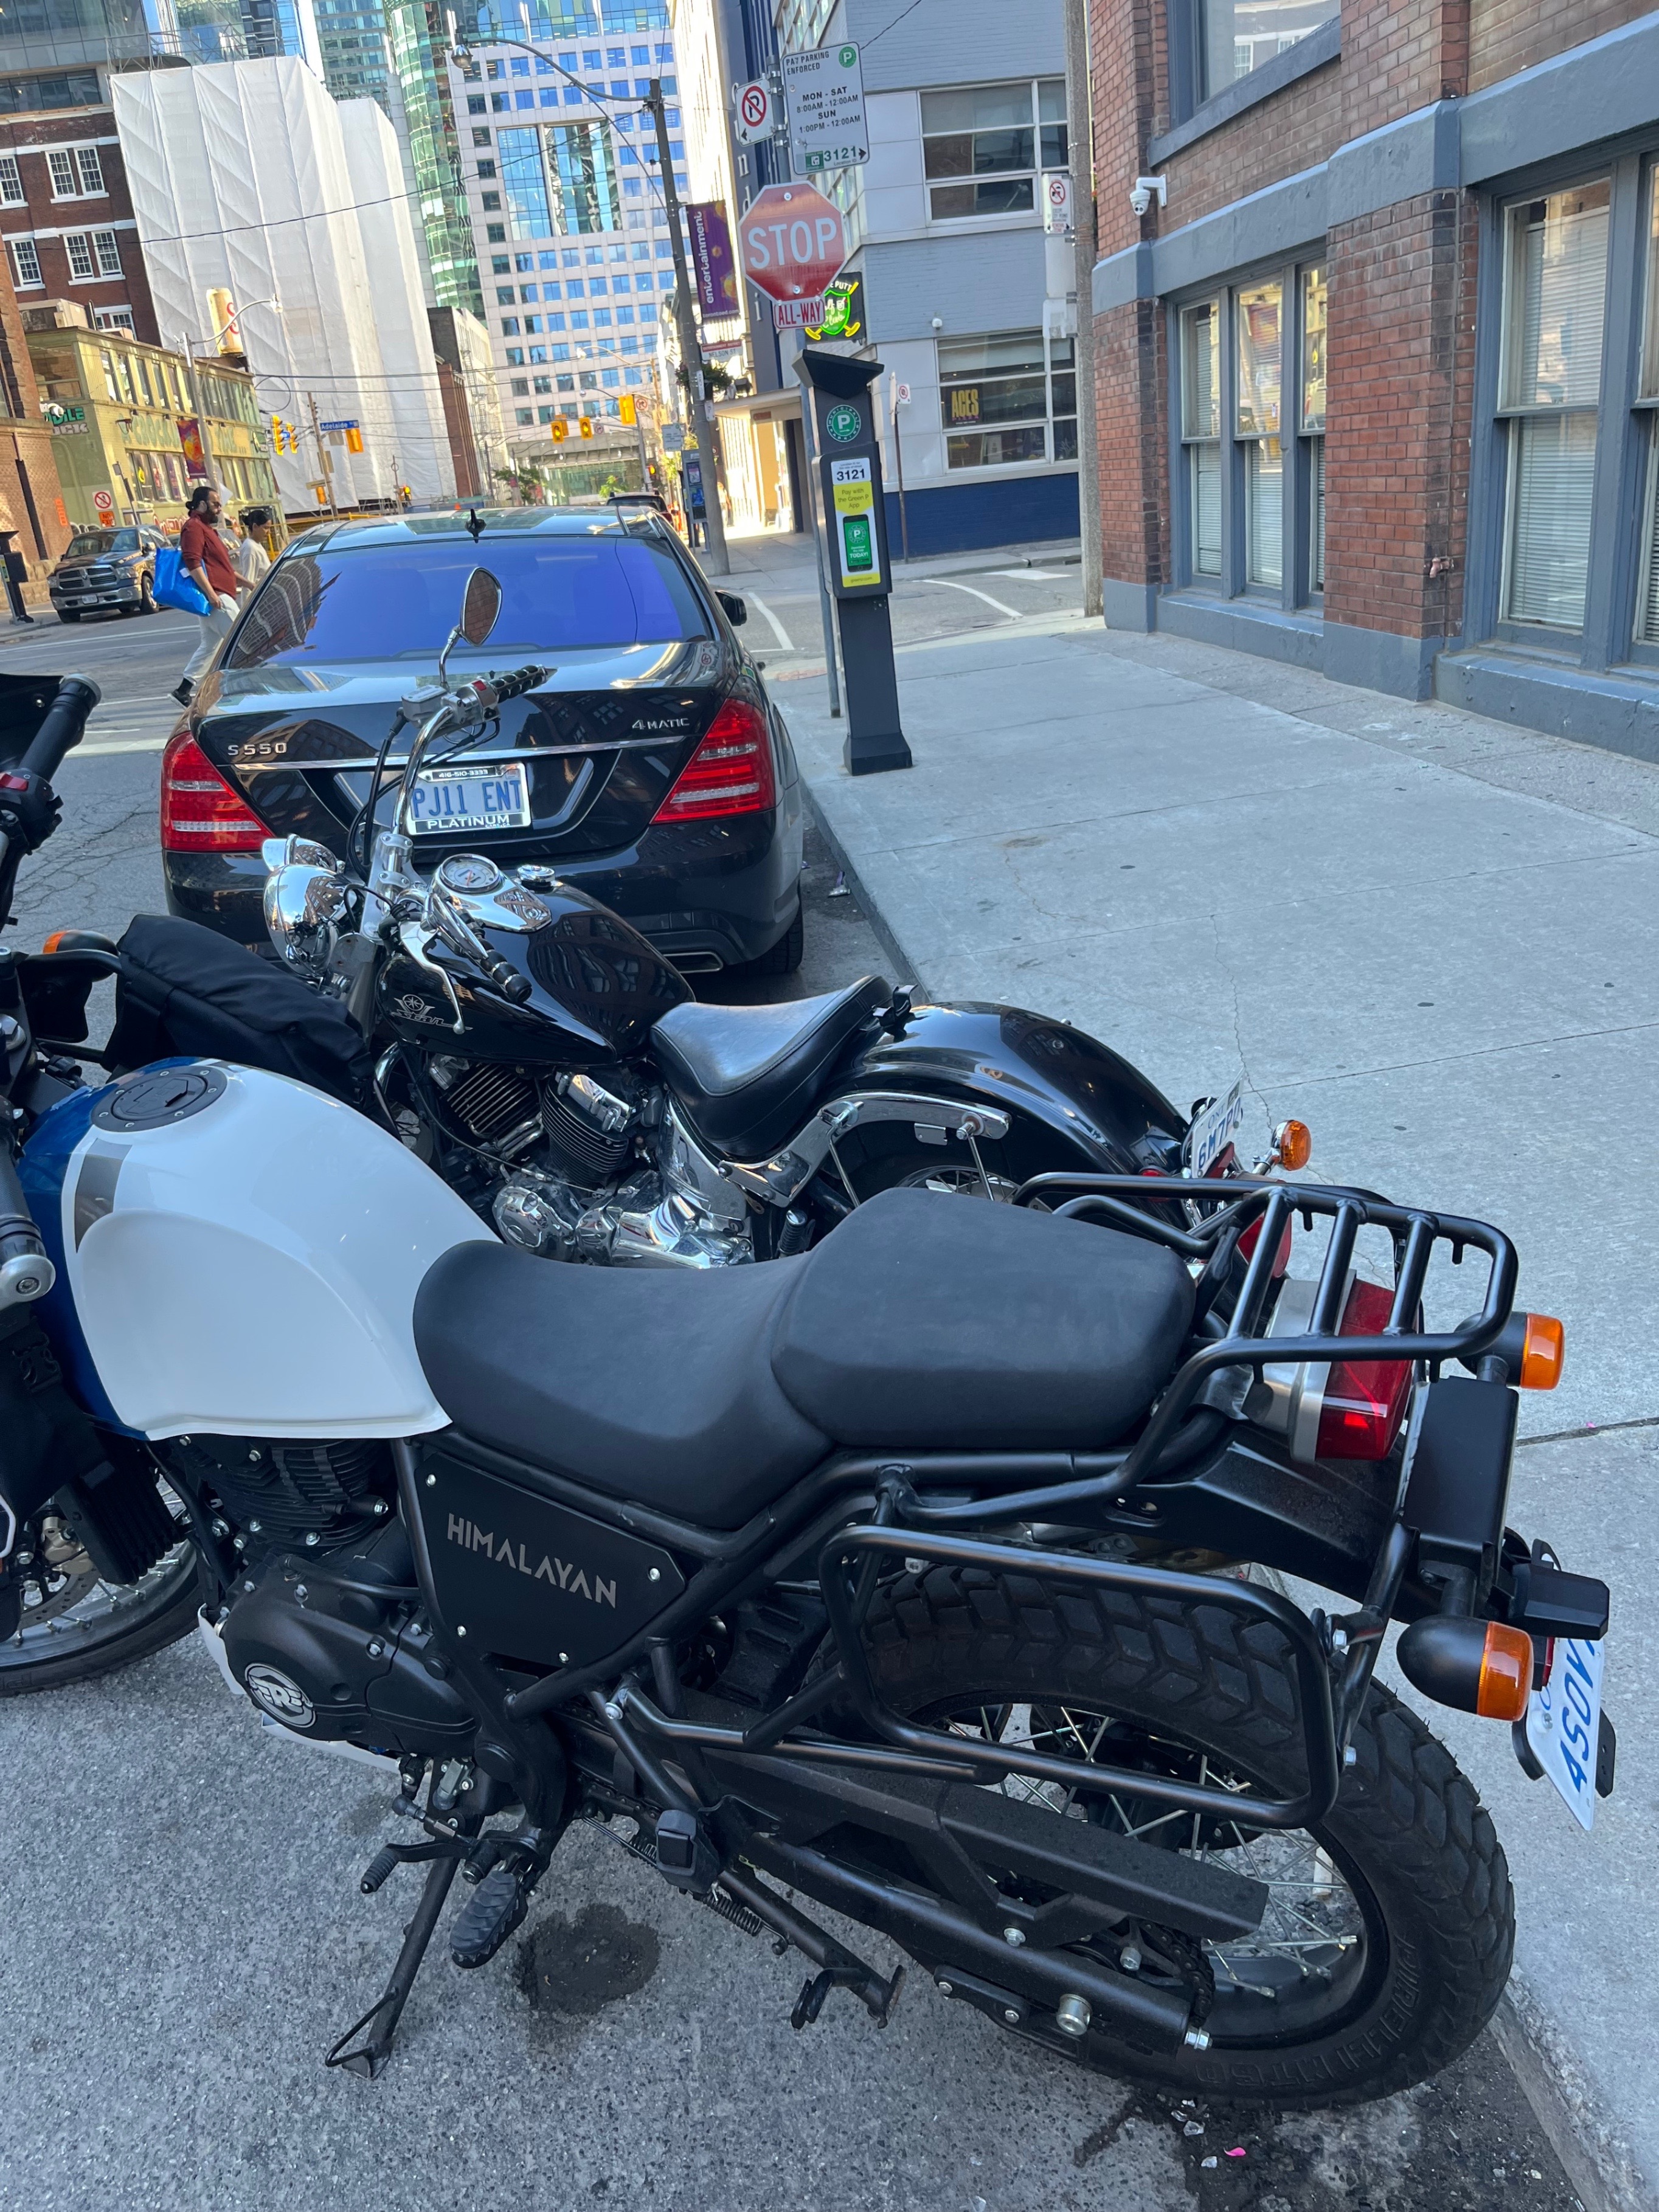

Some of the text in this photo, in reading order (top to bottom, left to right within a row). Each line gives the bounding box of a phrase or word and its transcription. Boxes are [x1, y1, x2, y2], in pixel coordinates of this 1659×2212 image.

[800, 51, 830, 63] PARKING
[787, 63, 820, 75] ENFORCED
[802, 92, 823, 102] MON
[831, 86, 848, 95] SAT
[797, 102, 823, 113] 8:00AM
[830, 95, 859, 107] 12:00AM
[818, 109, 836, 119] SUN
[799, 122, 825, 133] 1:00PM
[831, 116, 861, 128] 12:00AM
[824, 146, 856, 162] 3121
[748, 217, 837, 269] STOP
[694, 211, 715, 304] entertainment
[835, 280, 853, 291] PUTT
[778, 302, 821, 325] ALL-WAY
[951, 389, 979, 417] ACES
[837, 414, 850, 429] P
[837, 468, 865, 481] 3121
[632, 718, 690, 730] 4MATIC
[438, 769, 488, 778] 416-510-3333
[412, 779, 521, 818] PJ11 ENT
[427, 815, 510, 830] PLATINUM
[447, 1513, 617, 1609] HIMALAYAN
